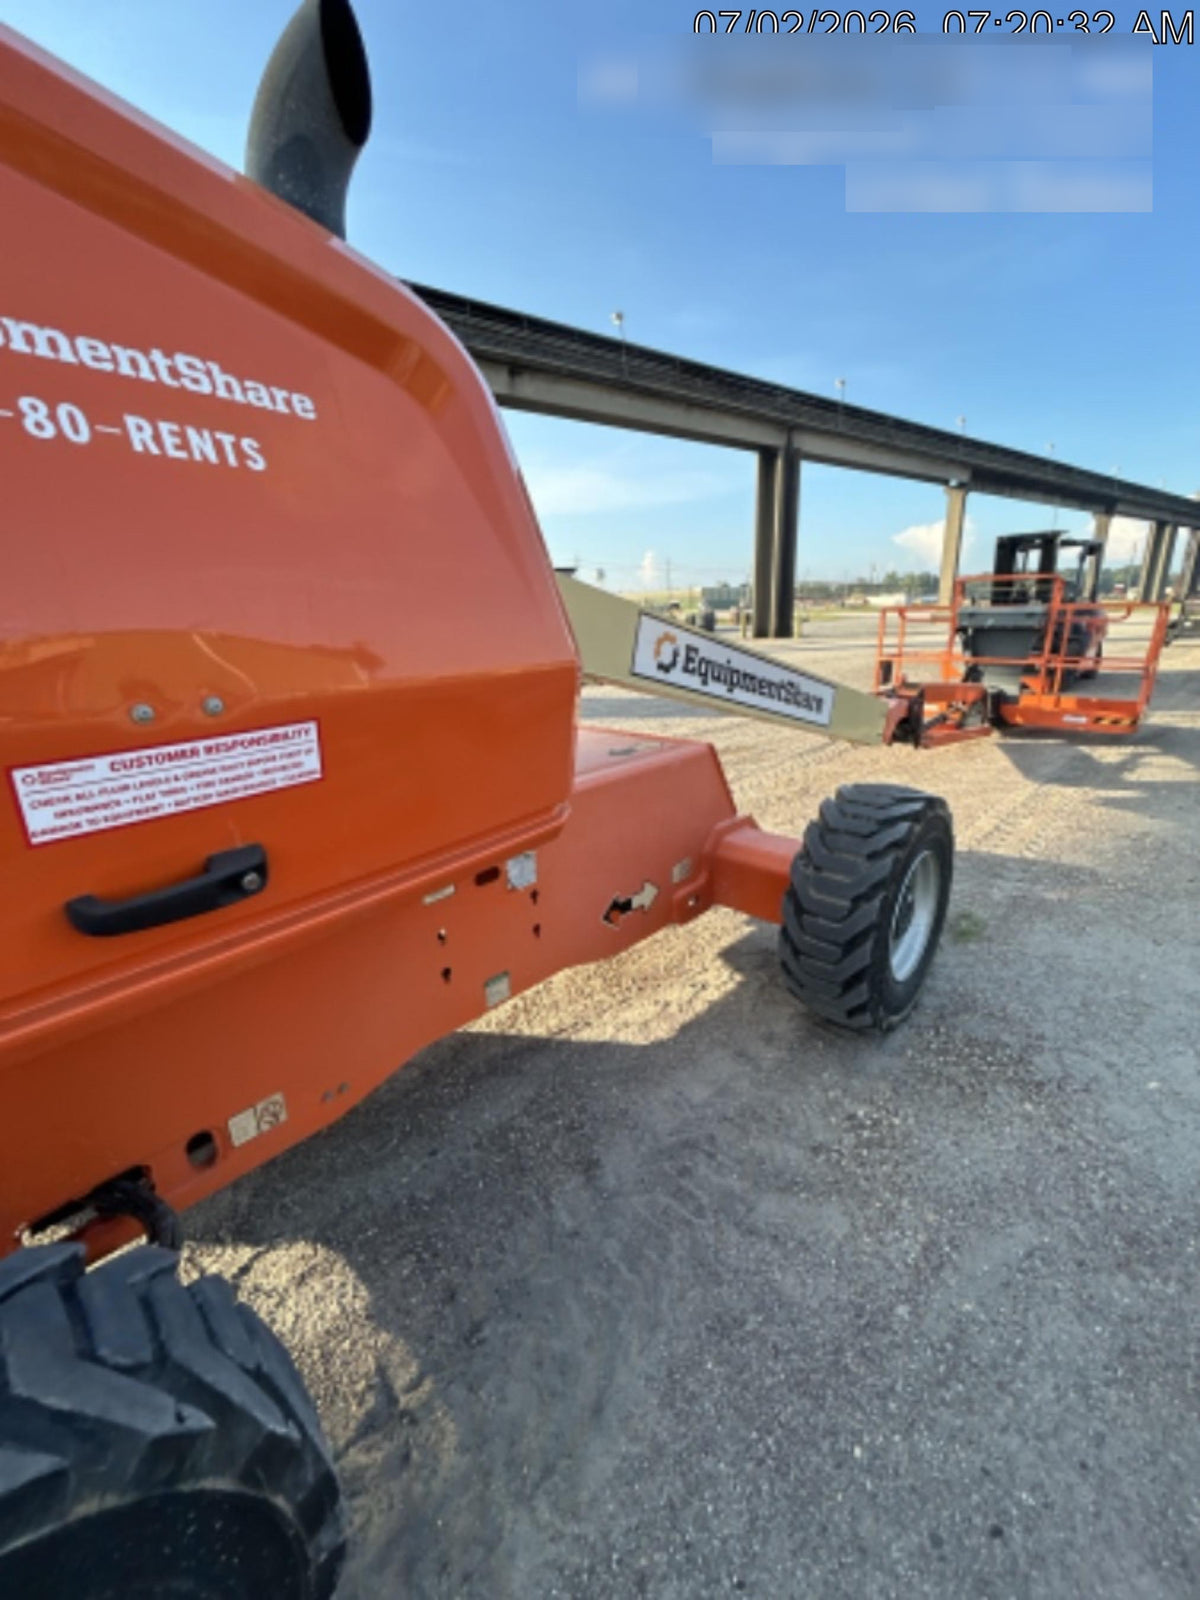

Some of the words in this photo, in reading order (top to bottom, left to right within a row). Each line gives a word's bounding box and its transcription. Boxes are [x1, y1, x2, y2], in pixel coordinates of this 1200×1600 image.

[0, 317, 317, 420] mentShare
[109, 748, 200, 773] CUSTOMER
[203, 726, 311, 756] RESPONSIBILITY
